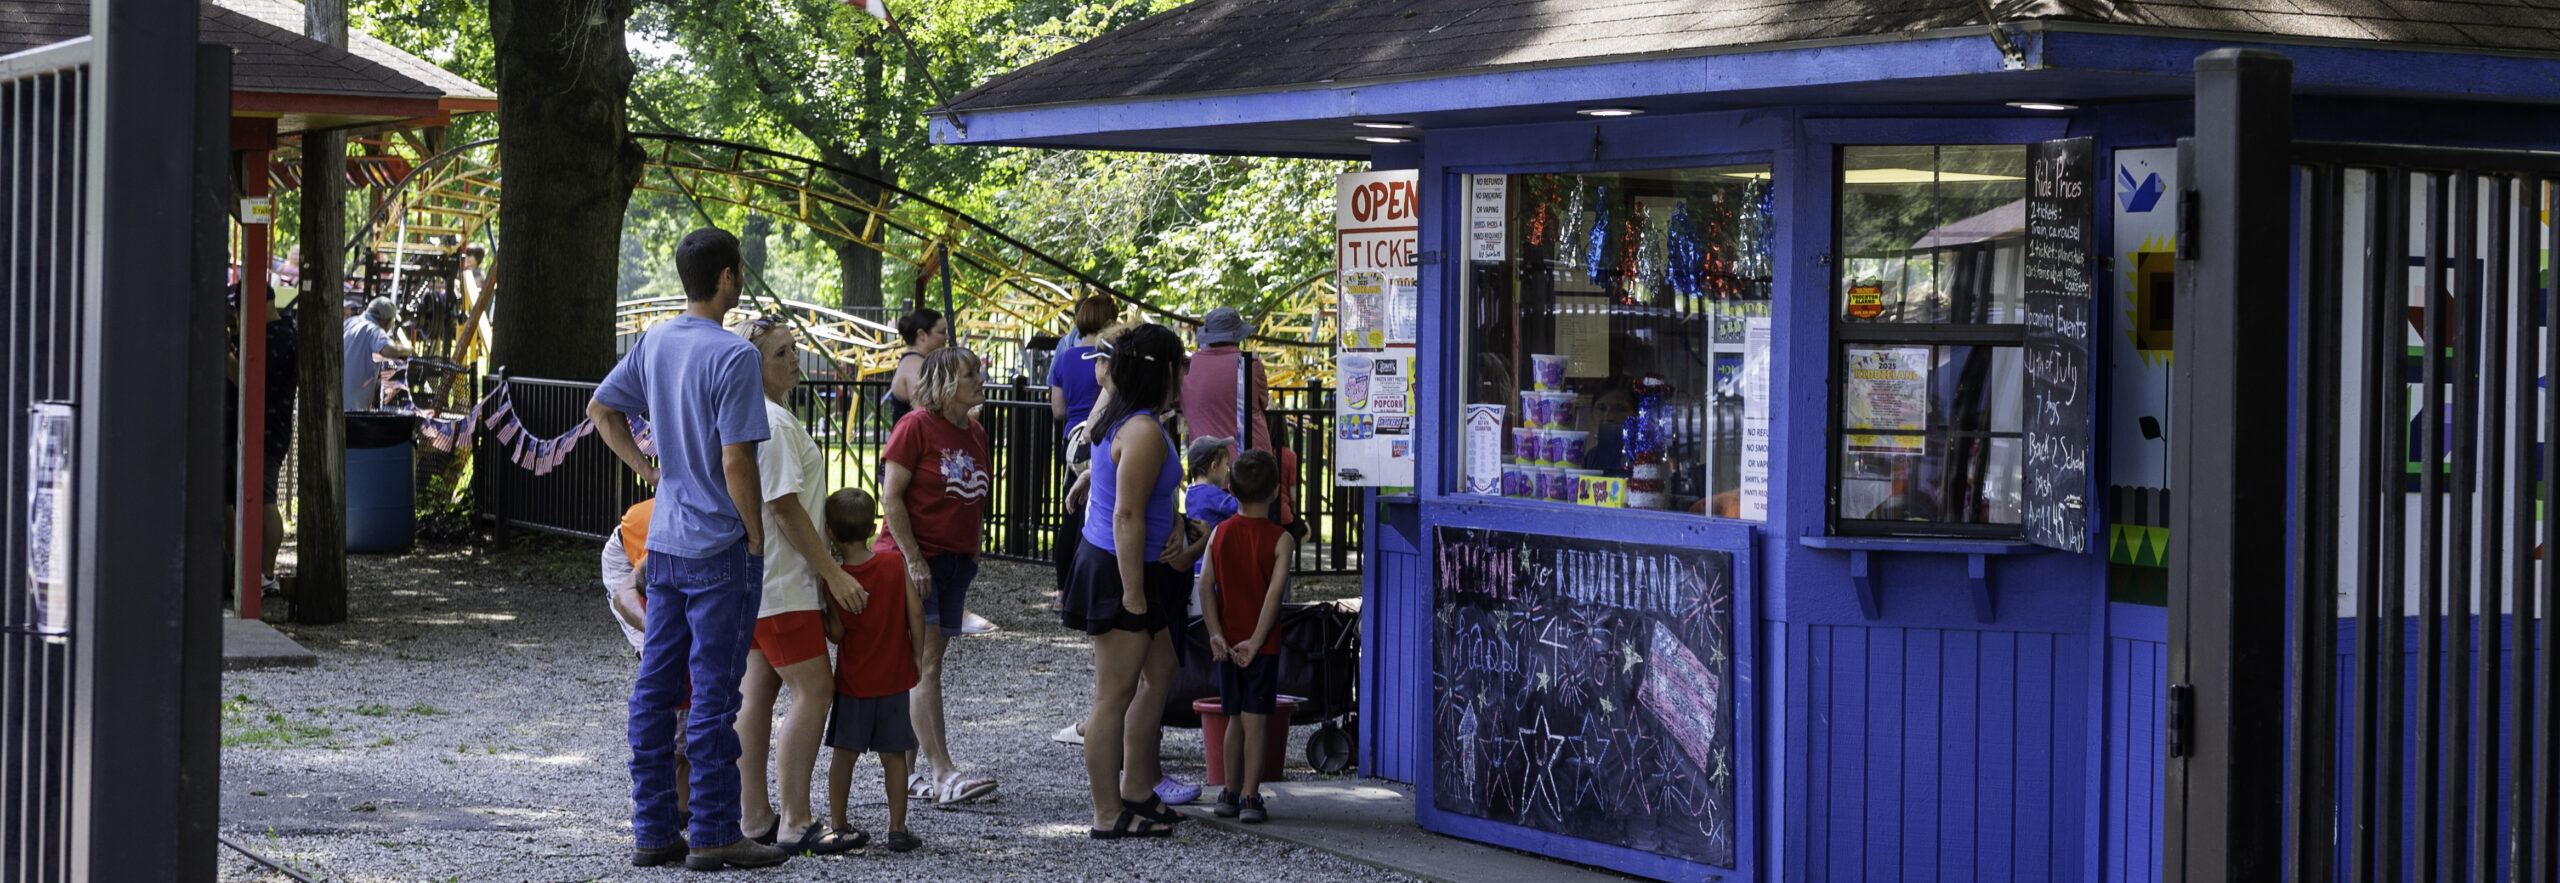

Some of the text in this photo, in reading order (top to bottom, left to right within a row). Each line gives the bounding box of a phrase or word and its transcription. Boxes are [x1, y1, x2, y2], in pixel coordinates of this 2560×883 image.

[1483, 177, 1503, 186] REFUNDS
[2034, 155, 2082, 199] Ride Prices
[1351, 179, 1418, 223] OPEN
[1482, 191, 1502, 200] SMOKING
[1483, 206, 1499, 214] VAPING
[2031, 201, 2037, 219] 2
[2048, 218, 2080, 242] carousel
[2029, 240, 2036, 257] 1
[2058, 304, 2087, 340] Events
[1878, 362, 1897, 370] 2025
[1854, 368, 1920, 381] KIDDIELAND
[2053, 350, 2078, 406] July
[1374, 399, 1403, 408] POPCORN
[1747, 428, 1756, 436] NO
[1746, 443, 1754, 452] NO
[2028, 432, 2085, 476] Back 2 School
[1747, 460, 1755, 468] OR
[1744, 489, 1757, 497] PANTS
[1531, 549, 1553, 588] to
[1556, 548, 1685, 618] KIDDIELAND
